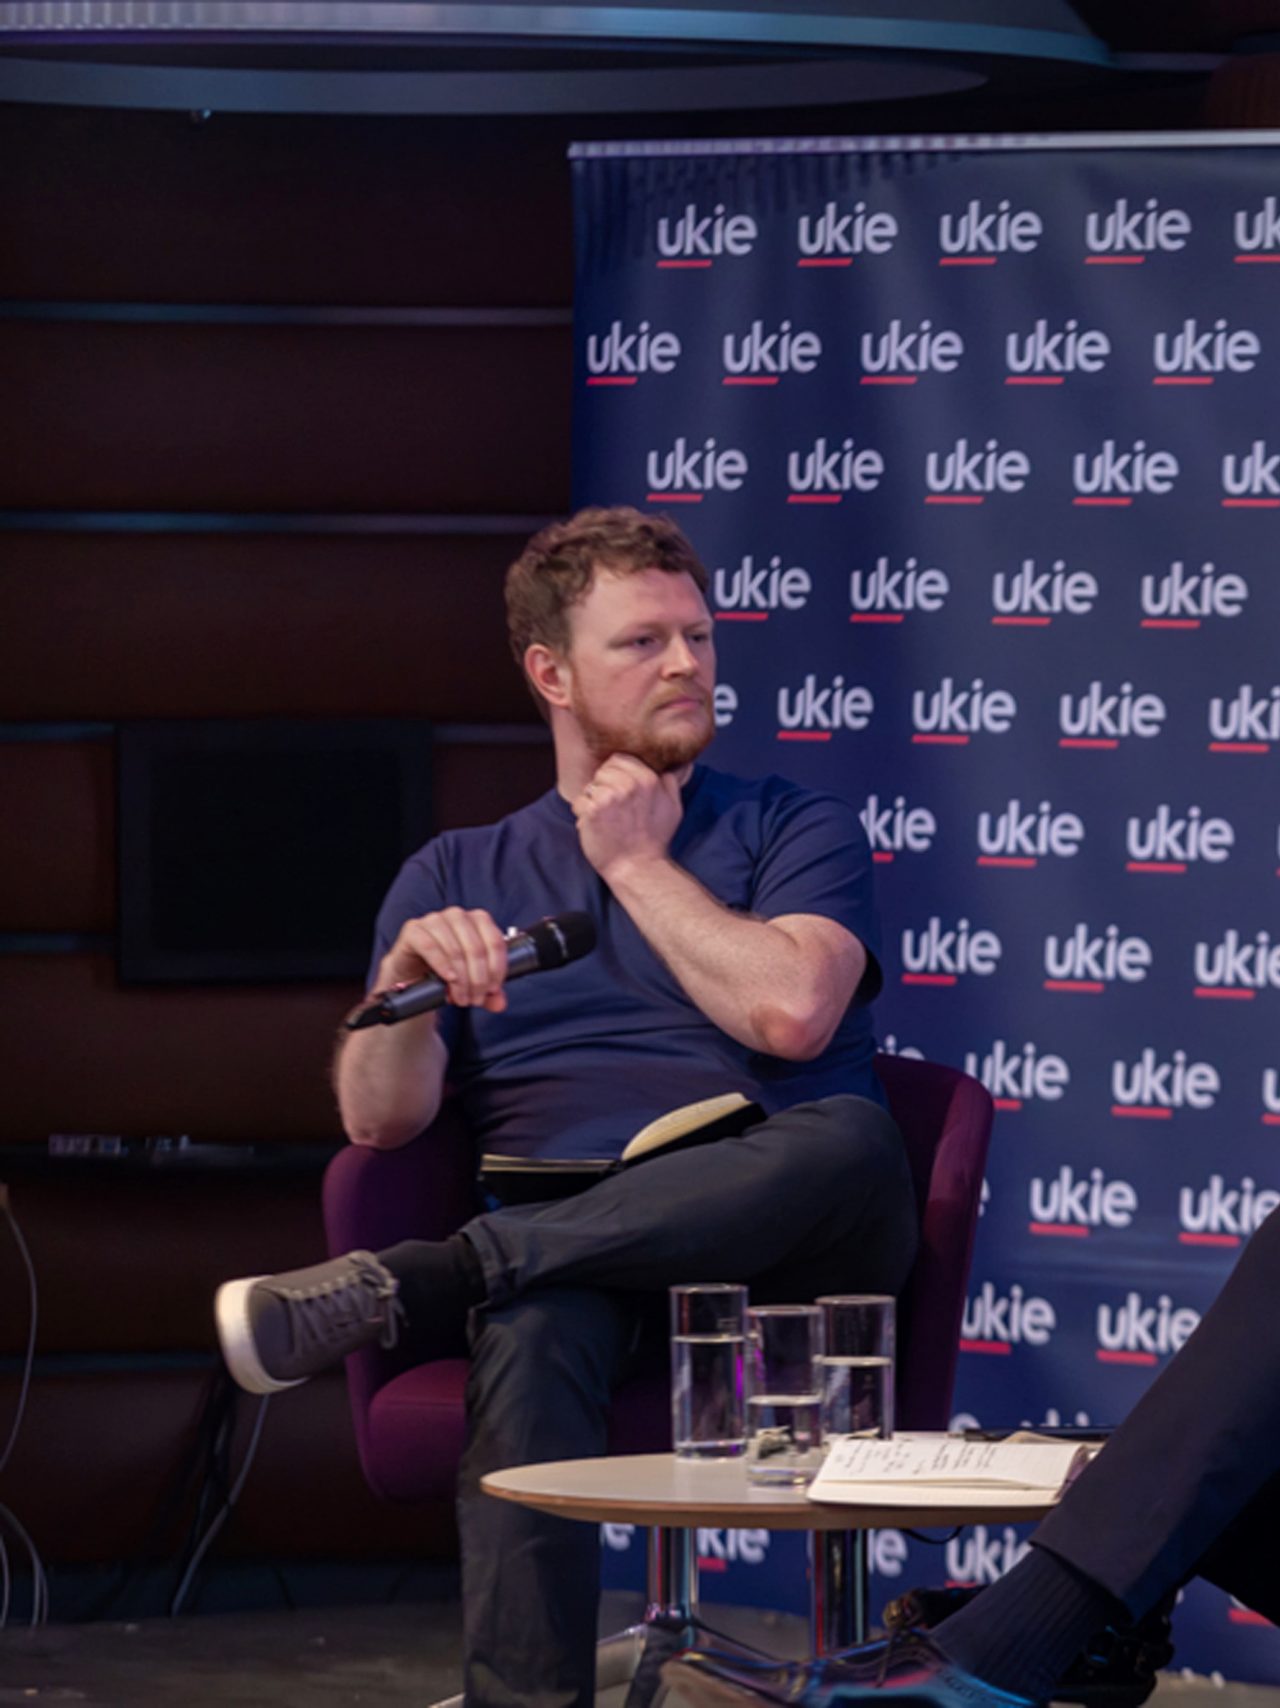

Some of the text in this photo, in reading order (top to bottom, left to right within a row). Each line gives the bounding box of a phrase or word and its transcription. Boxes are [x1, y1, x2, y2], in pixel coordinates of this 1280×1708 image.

[659, 205, 757, 256] ukie
[799, 202, 898, 254] ukie
[941, 200, 1042, 252] ukie
[1086, 199, 1191, 251] ukie
[588, 321, 680, 372] ukie
[724, 321, 821, 373] ukie
[862, 320, 963, 372] ukie
[1007, 320, 1110, 372] ukie
[1154, 319, 1260, 372] ukie
[648, 438, 747, 490] ukie
[789, 439, 884, 491] ukie
[927, 439, 1030, 492] ukie
[1074, 440, 1178, 493] ukie
[715, 556, 811, 608] ukie
[852, 558, 949, 611] ukie
[993, 560, 1097, 613] ukie
[1142, 562, 1247, 616] ukie
[778, 675, 873, 729] ukie
[914, 678, 1016, 732] ukie
[1060, 682, 1165, 736] ukie
[978, 800, 1083, 856] ukie
[1128, 805, 1234, 862] ukie
[903, 918, 1001, 974] ukie
[1045, 924, 1151, 981] ukie
[1113, 1049, 1219, 1108] ukie
[1031, 1167, 1136, 1226] ukie
